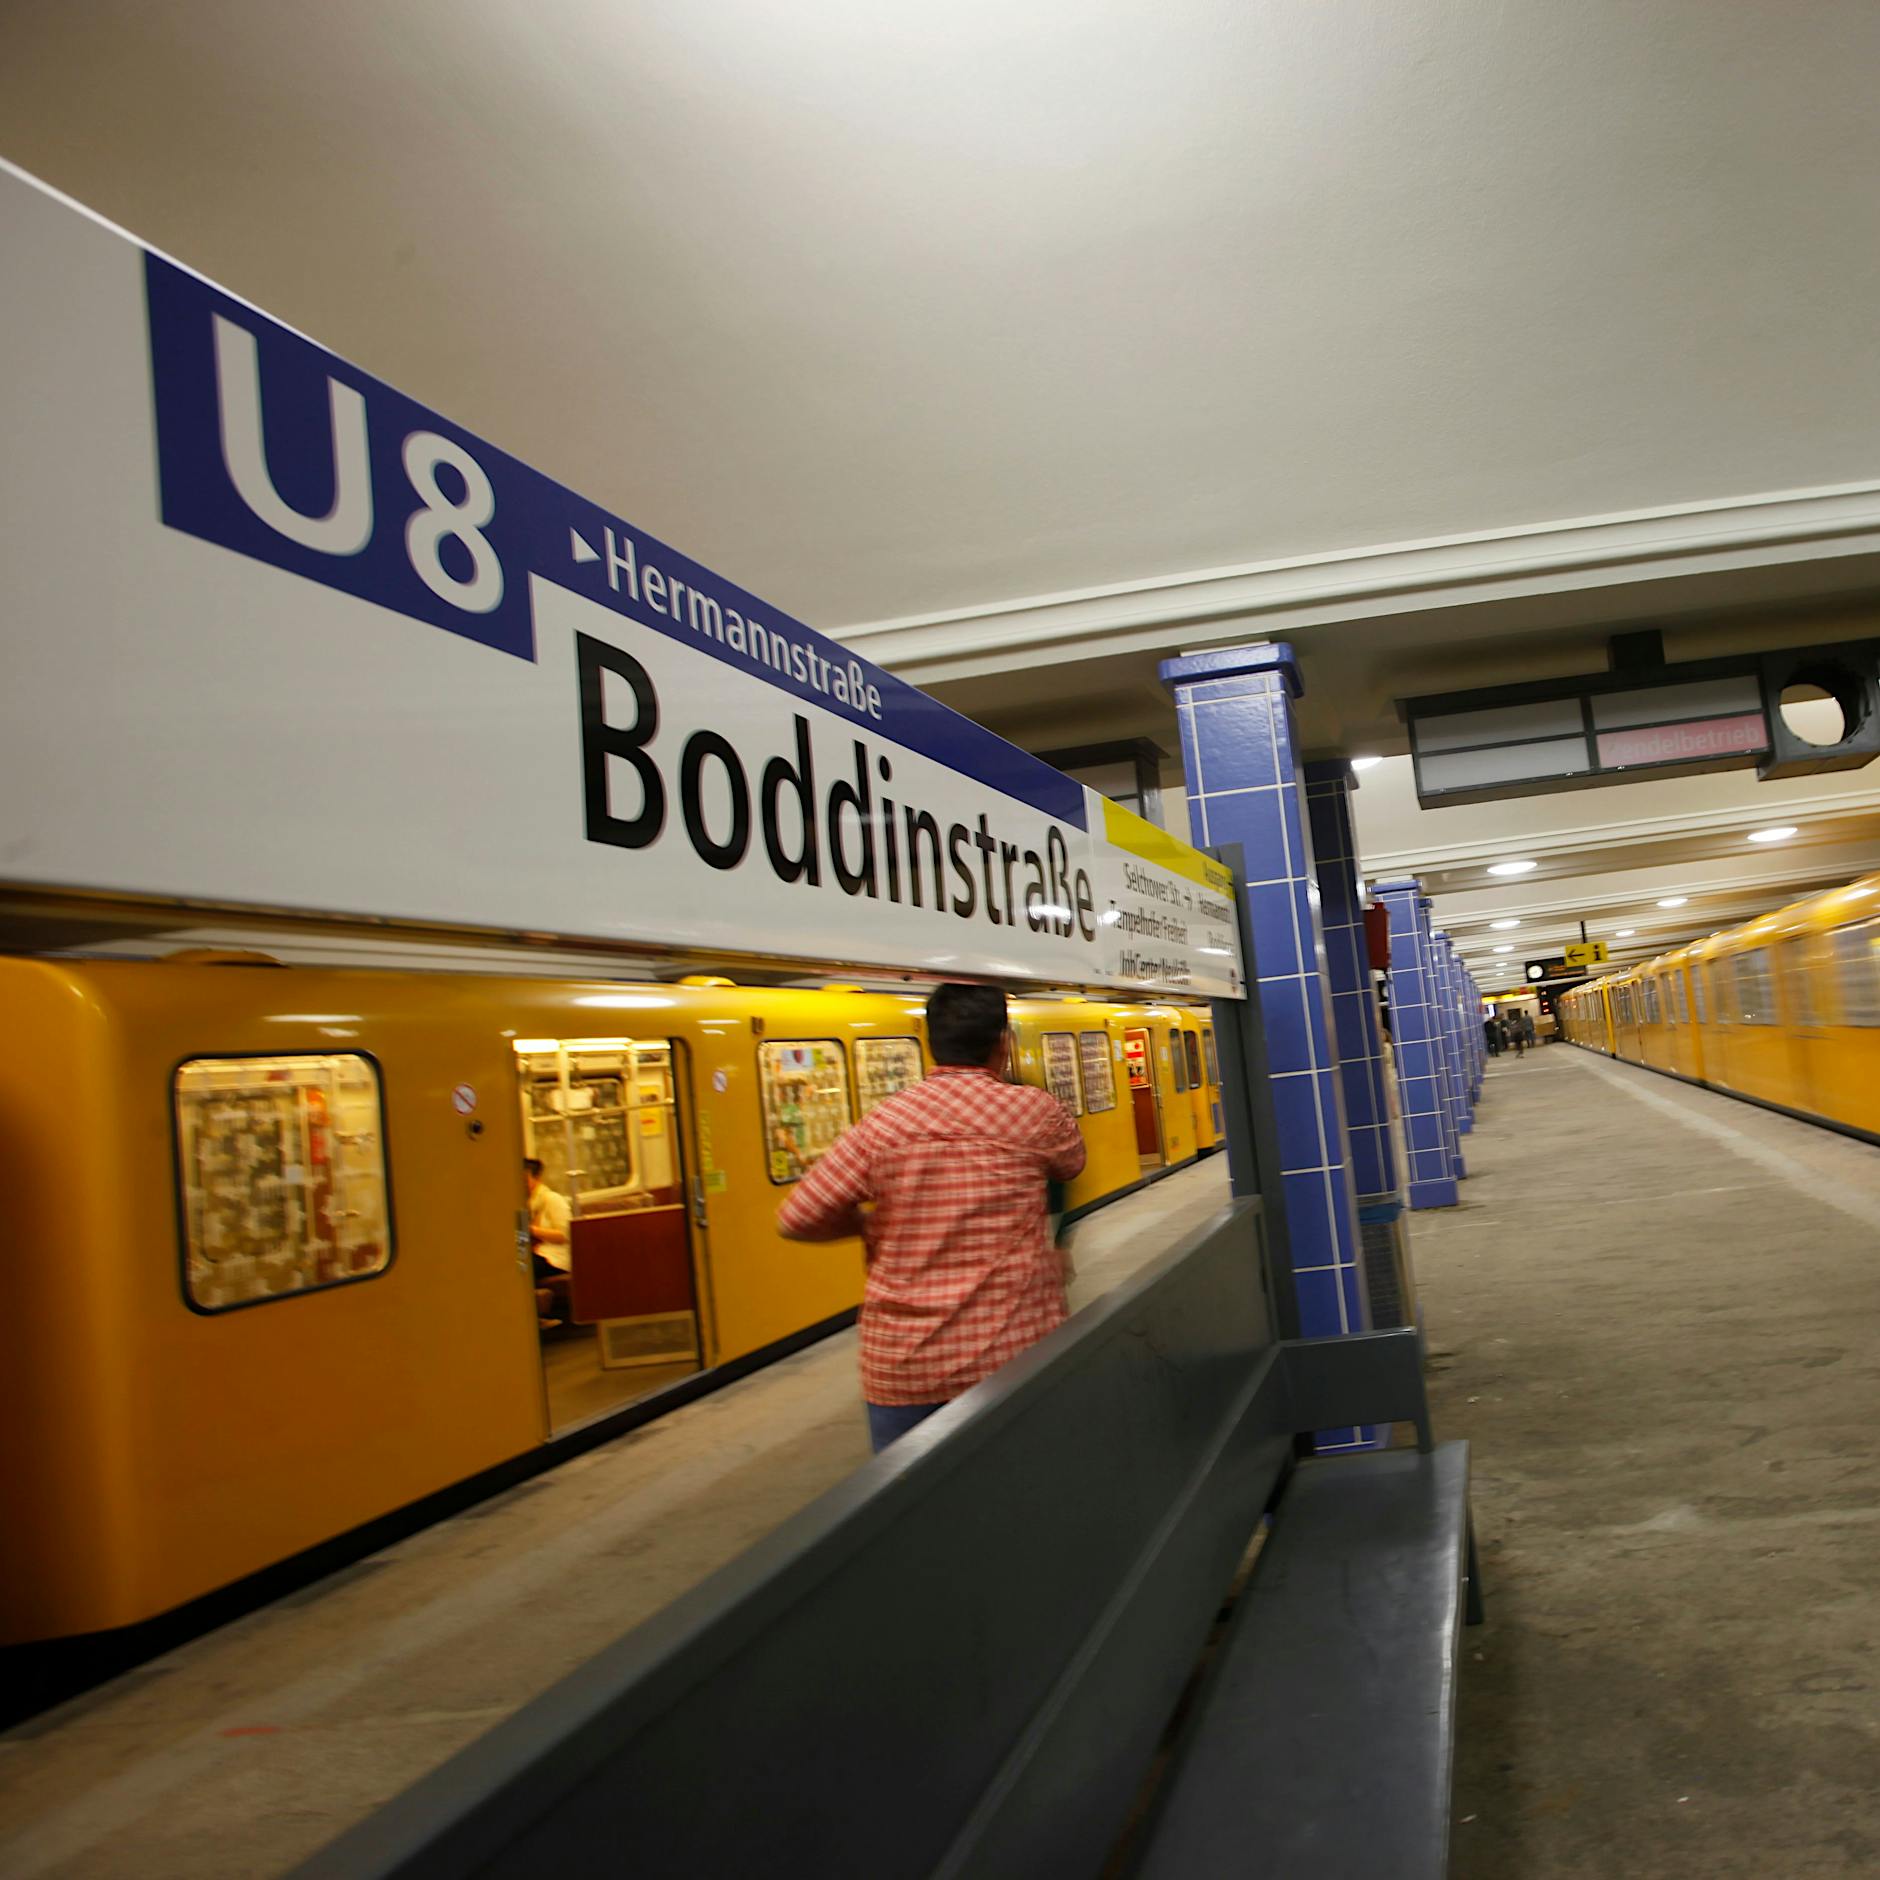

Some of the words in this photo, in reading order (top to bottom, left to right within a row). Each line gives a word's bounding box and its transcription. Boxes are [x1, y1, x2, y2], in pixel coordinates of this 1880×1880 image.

[212, 311, 504, 614] U8
[603, 526, 882, 721] Hermannstraße
[574, 629, 1096, 942] Boddinstraße
